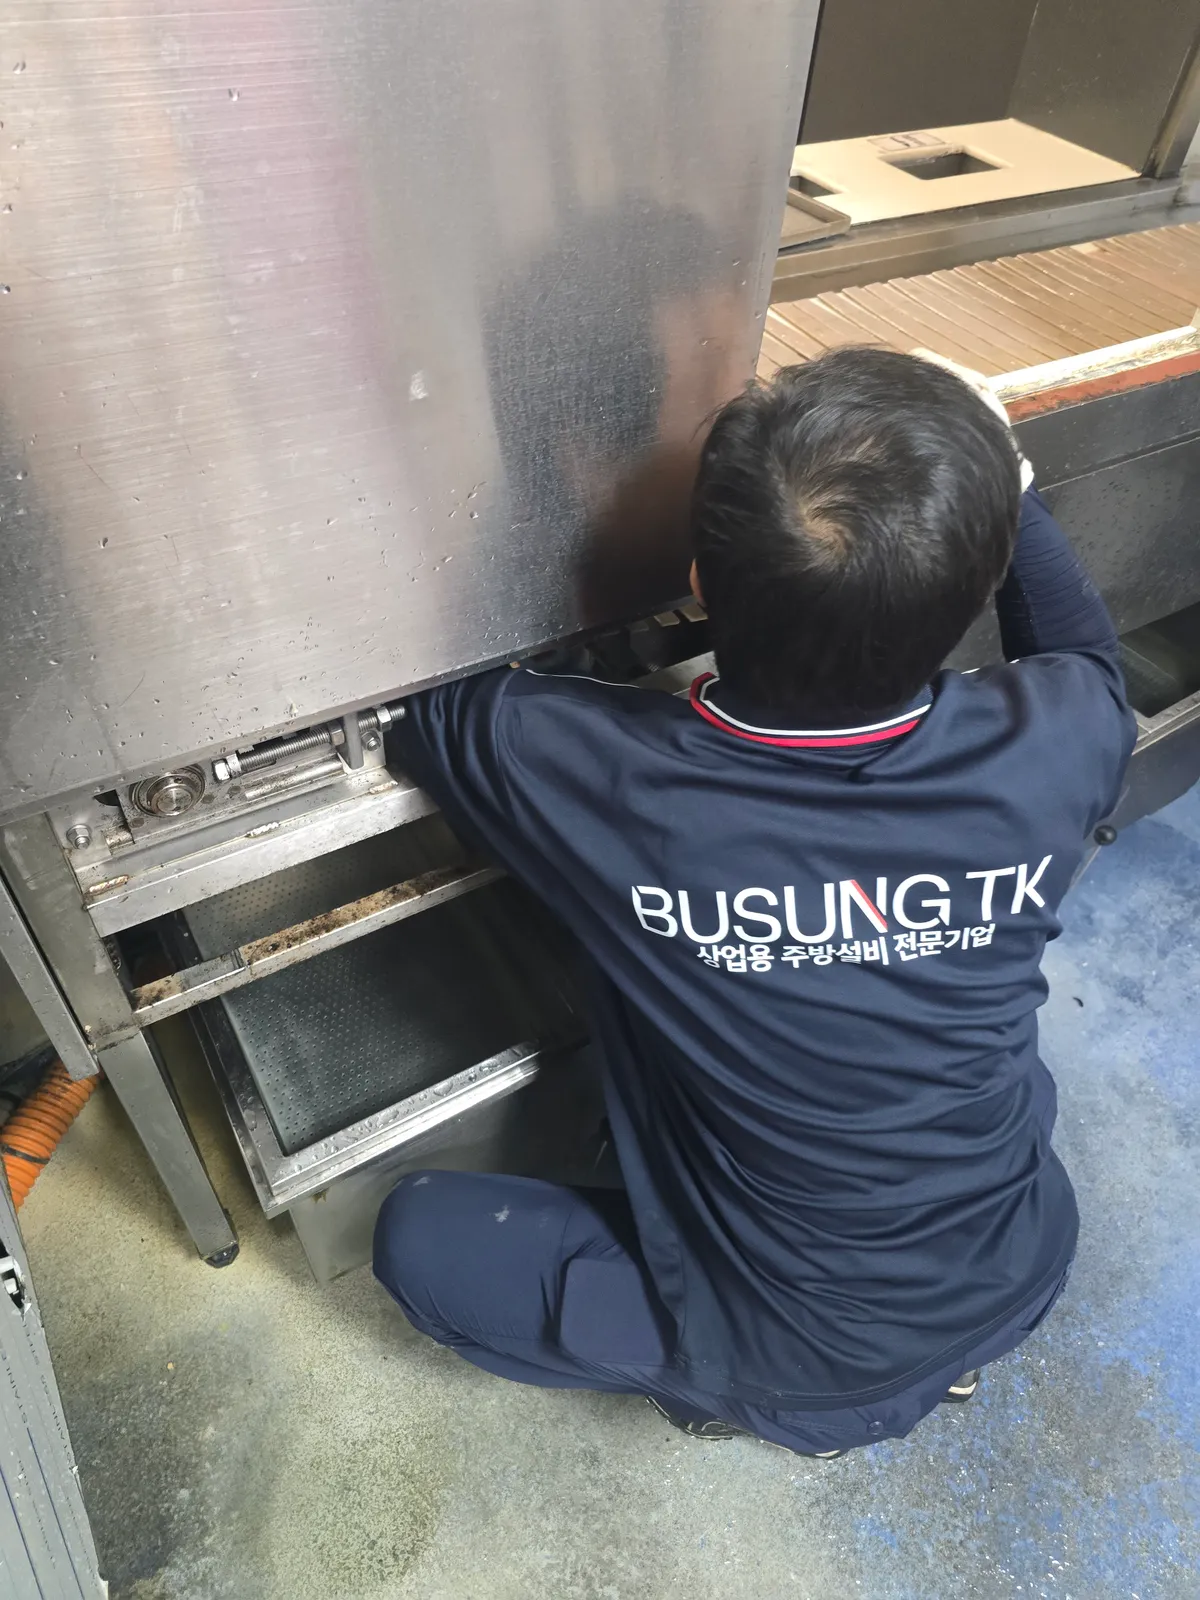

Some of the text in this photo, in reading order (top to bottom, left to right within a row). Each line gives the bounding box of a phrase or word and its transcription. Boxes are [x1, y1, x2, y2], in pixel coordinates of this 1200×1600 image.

[631, 855, 1052, 944] BUSUNG TK
[697, 923, 996, 973] 상업용 주방설비 전문기업
